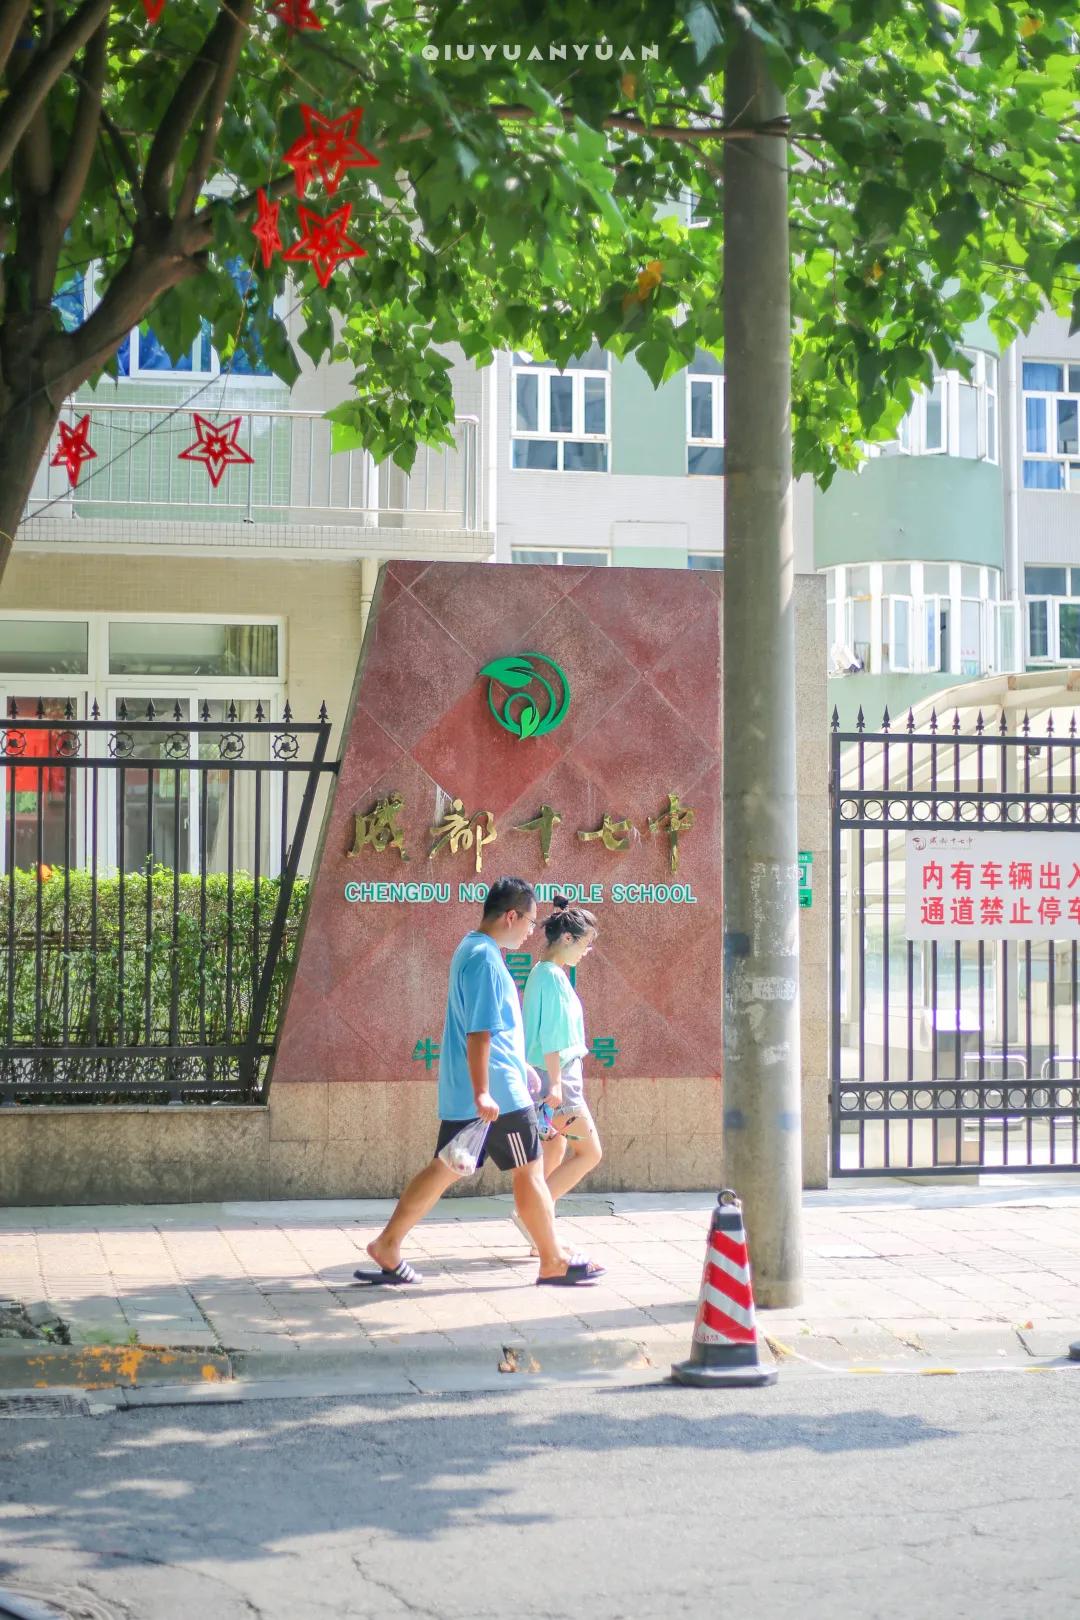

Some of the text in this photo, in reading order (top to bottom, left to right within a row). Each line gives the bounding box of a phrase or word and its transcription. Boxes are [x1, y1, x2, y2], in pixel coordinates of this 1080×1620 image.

[344, 881, 451, 903] CHENGDU
[611, 882, 697, 904] SCHOOL
[920, 896, 1080, 926] 通道禁止停车
